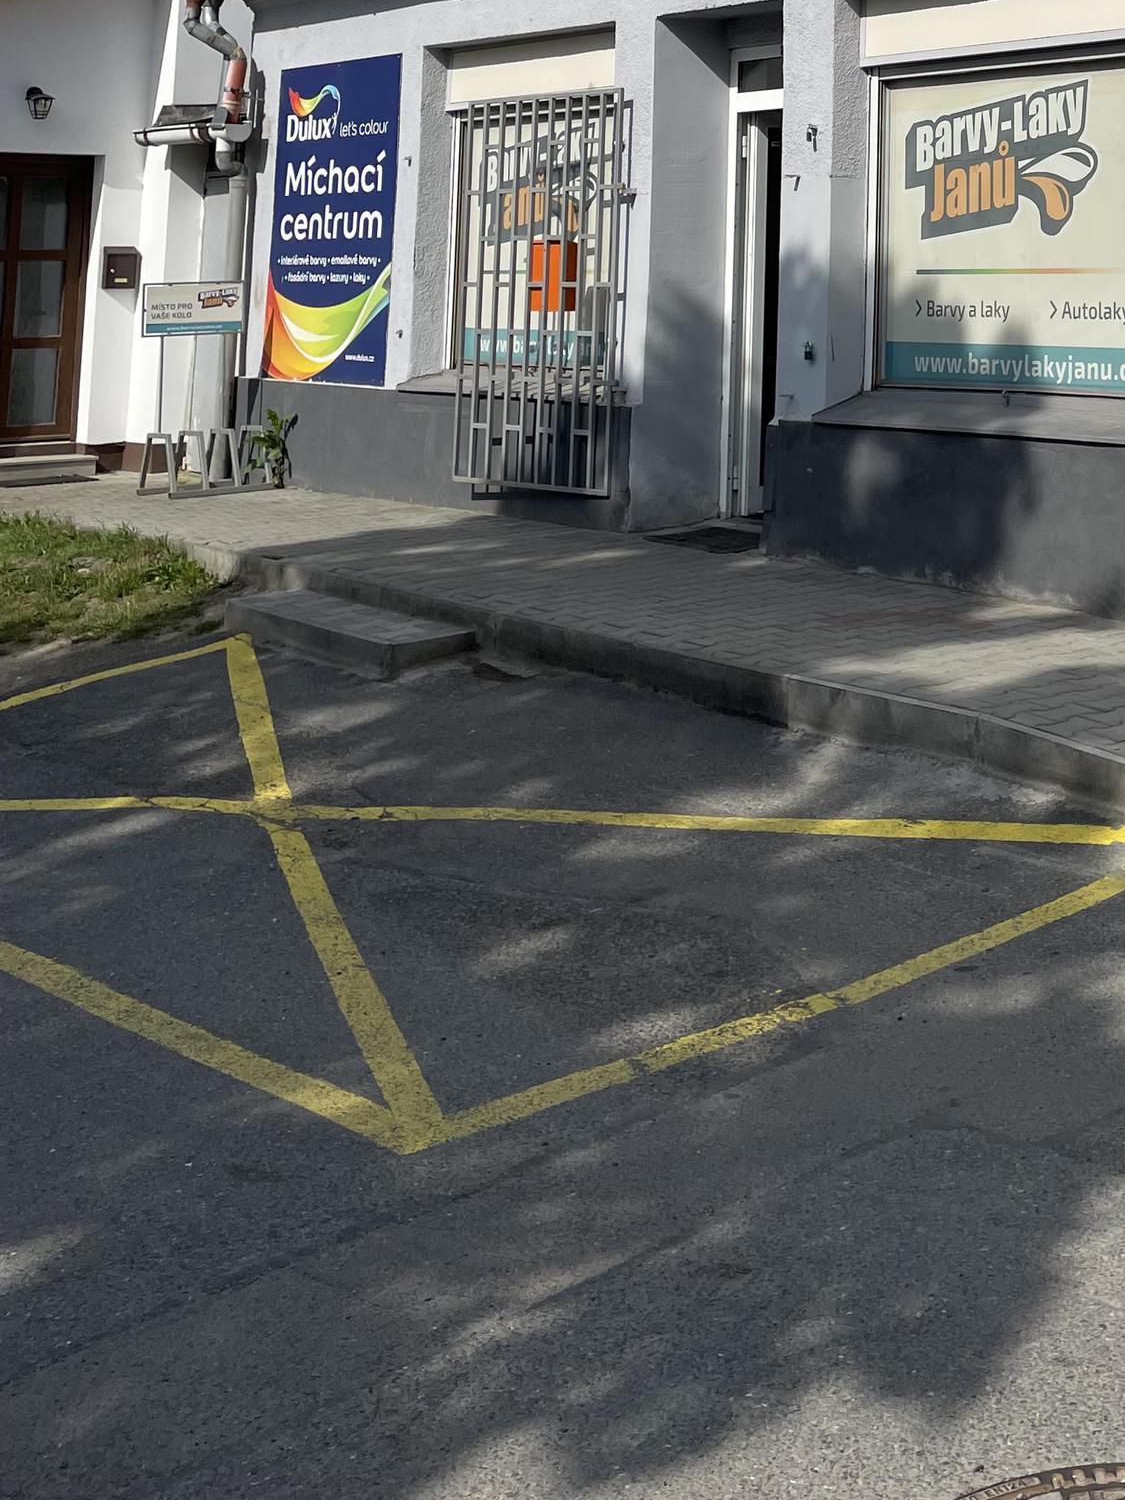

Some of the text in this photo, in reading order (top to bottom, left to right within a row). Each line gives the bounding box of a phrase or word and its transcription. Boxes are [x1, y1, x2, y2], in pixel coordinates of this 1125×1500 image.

[286, 115, 388, 142] Dulux let's colour
[916, 86, 1085, 173] Barvy-Laky
[285, 150, 387, 197] Míchací
[930, 140, 1015, 222] Janů
[280, 204, 382, 241] centrum
[151, 302, 193, 311] MÍSTO PRO
[151, 311, 192, 320] VAŠE KOLO
[927, 300, 1010, 323] Barvy a laky
